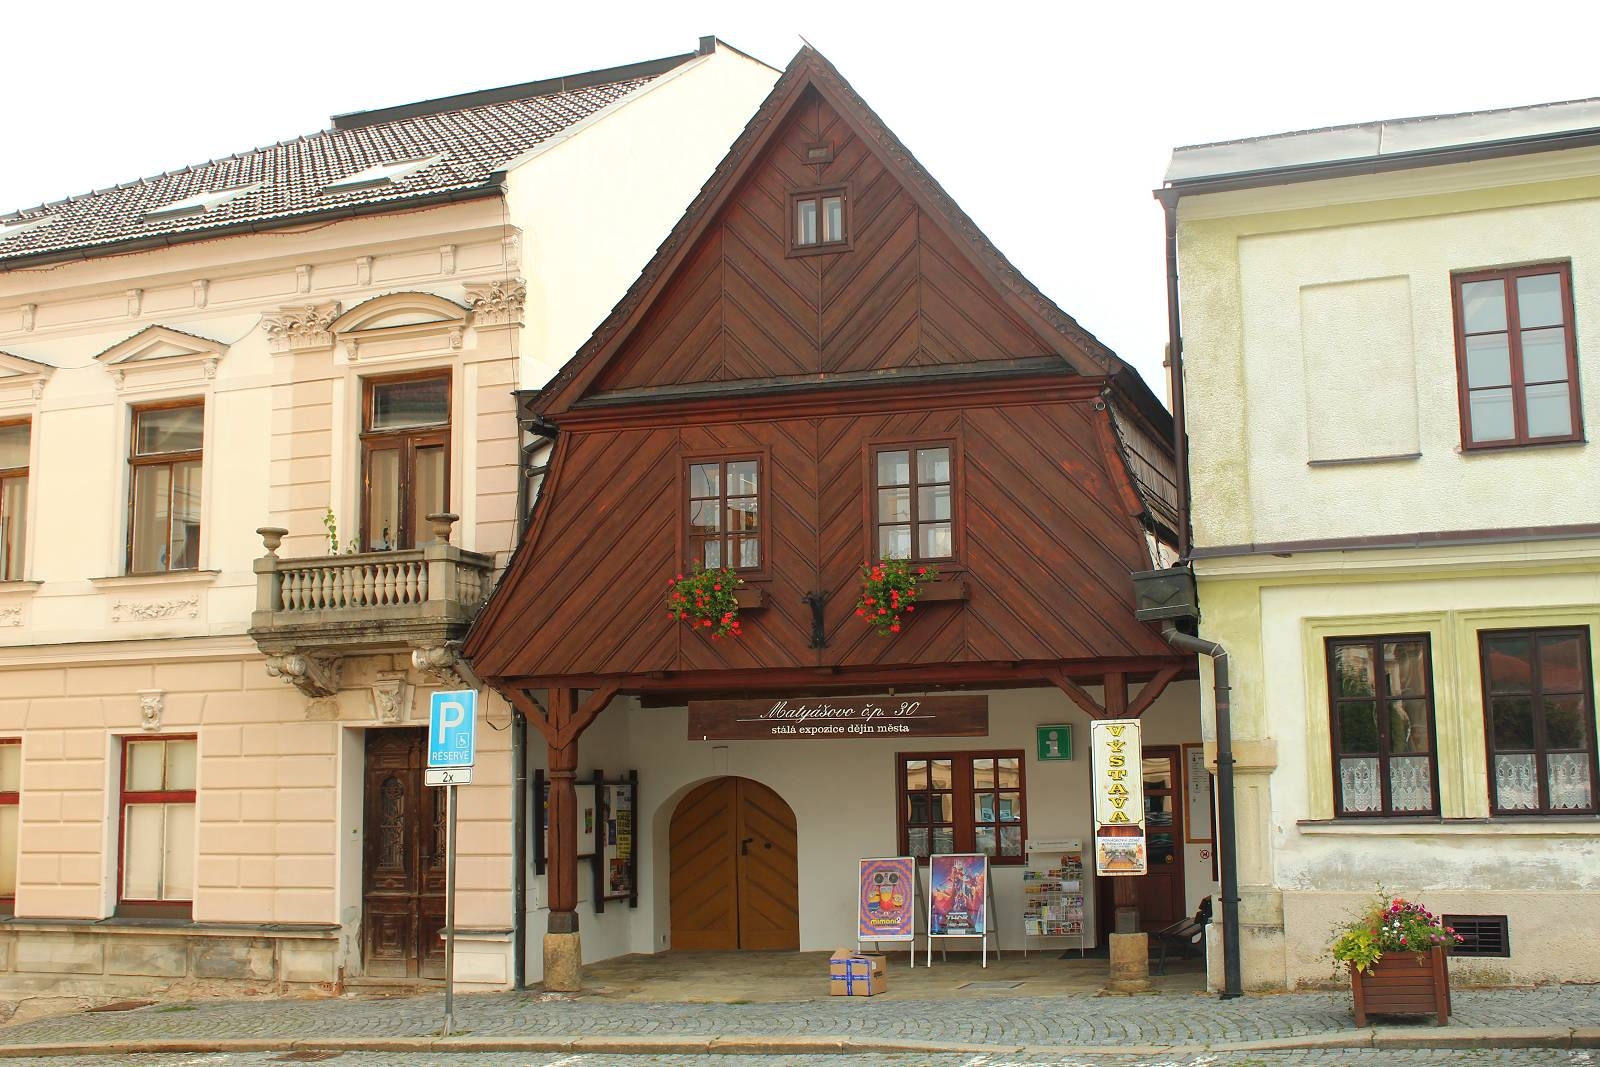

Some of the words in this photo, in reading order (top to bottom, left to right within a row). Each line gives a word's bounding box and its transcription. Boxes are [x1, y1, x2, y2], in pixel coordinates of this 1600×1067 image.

[760, 701, 854, 723] Matyášovo
[894, 701, 920, 716] 30
[438, 701, 465, 745] P
[771, 725, 796, 734] stálá
[799, 726, 844, 736] expozice
[847, 723, 874, 734] dějin
[877, 724, 909, 733] města
[442, 771, 454, 782] 2x
